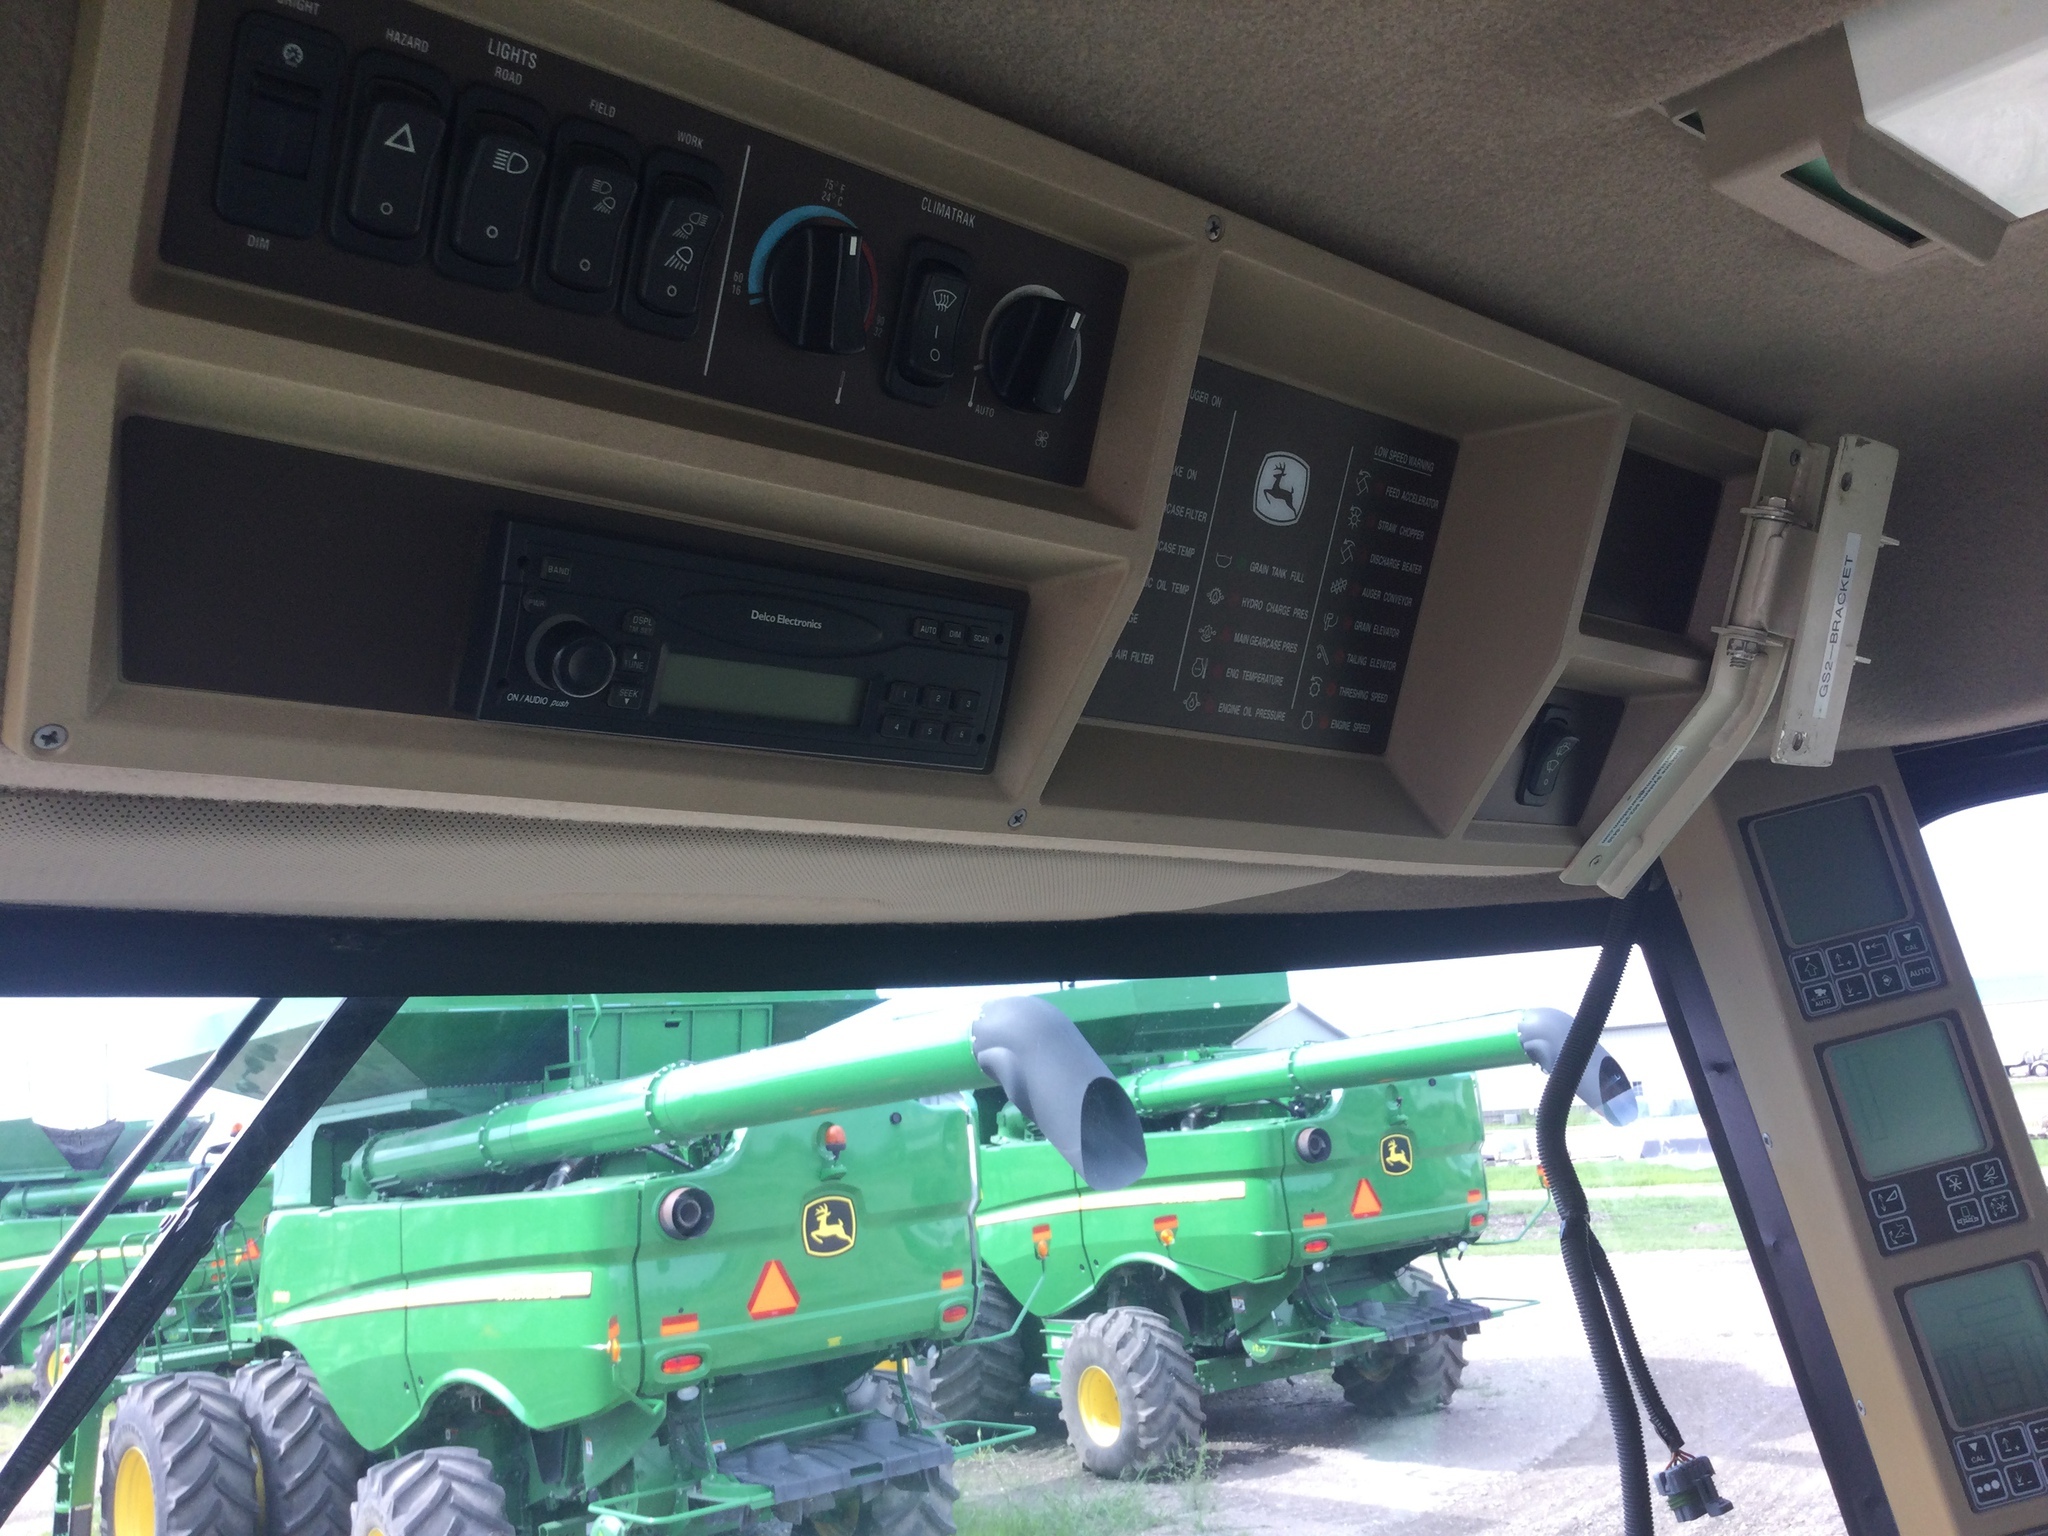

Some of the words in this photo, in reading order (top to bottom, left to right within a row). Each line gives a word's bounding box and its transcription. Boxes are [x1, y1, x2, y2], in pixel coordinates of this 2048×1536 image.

[385, 28, 430, 54] HAZARD
[487, 38, 538, 70] LIGHTS
[494, 66, 523, 86] ROAD
[589, 100, 616, 119] FIELD
[677, 130, 704, 150] WORK
[921, 196, 976, 229] CLIMATRAK
[247, 234, 270, 251] DIM
[733, 271, 744, 283] 60
[731, 284, 742, 296] 16
[1188, 389, 1210, 404] UGER
[1211, 395, 1223, 408] ON
[974, 404, 995, 418] AUTO
[1374, 445, 1389, 459] LOW
[1388, 449, 1409, 465] SPEED
[1408, 455, 1435, 473] WARNING
[1186, 467, 1198, 481] ON
[1385, 486, 1401, 499] FEED
[1401, 491, 1440, 509] ACCELERATOR
[1184, 507, 1208, 523] FILTER
[1377, 519, 1398, 534] STRAW
[1399, 526, 1425, 541] CHOPPER
[1177, 544, 1196, 559] TEMP
[548, 565, 570, 576] BAND
[1250, 561, 1270, 576] GRAIN
[1271, 566, 1288, 579] TANK
[1290, 571, 1305, 583] FULL
[1369, 554, 1401, 570] DISCHARGE
[1401, 561, 1423, 575] BEATER
[1156, 579, 1168, 592] OIL
[1171, 582, 1190, 595] TEMP
[1361, 587, 1382, 601] AUGER
[1383, 591, 1413, 607] CONVEYOR
[1241, 597, 1264, 611] HYDRO
[1265, 602, 1292, 616] CHARGE
[1292, 607, 1309, 620] PRES
[632, 615, 653, 627] DSPL
[750, 609, 776, 623] Delco
[776, 614, 823, 630] Electronics
[920, 624, 937, 636] AUTO
[949, 629, 962, 640] DIM
[1353, 620, 1372, 633] GRAIN
[1373, 625, 1400, 639] ELEVATOR
[973, 634, 990, 645] SCAN
[1233, 632, 1250, 645] MAIN
[1249, 635, 1282, 651] GEARCASE
[1282, 640, 1298, 654] PRES
[625, 660, 645, 670] TUNE
[1114, 648, 1129, 660] AIR
[1130, 651, 1155, 665] FILTER
[1369, 658, 1397, 671] ELEVATOR
[1226, 667, 1240, 680] ENG
[1242, 670, 1284, 687] TEMPERATURE
[620, 688, 639, 698] SEEK
[1339, 686, 1369, 700] THRESHING
[1370, 692, 1389, 704] SPEED
[550, 699, 570, 708] push
[1218, 703, 1241, 715] ENGINE
[1243, 706, 1253, 717] OIL
[1255, 708, 1286, 722] PRESSURE
[1330, 719, 1351, 731] ENGINE
[1352, 722, 1371, 734] SPEED
[1904, 944, 1918, 952] CAL
[1910, 966, 1931, 978] AUTO
[1815, 999, 1831, 1007] AUTO
[1970, 1454, 1986, 1464] CAL
